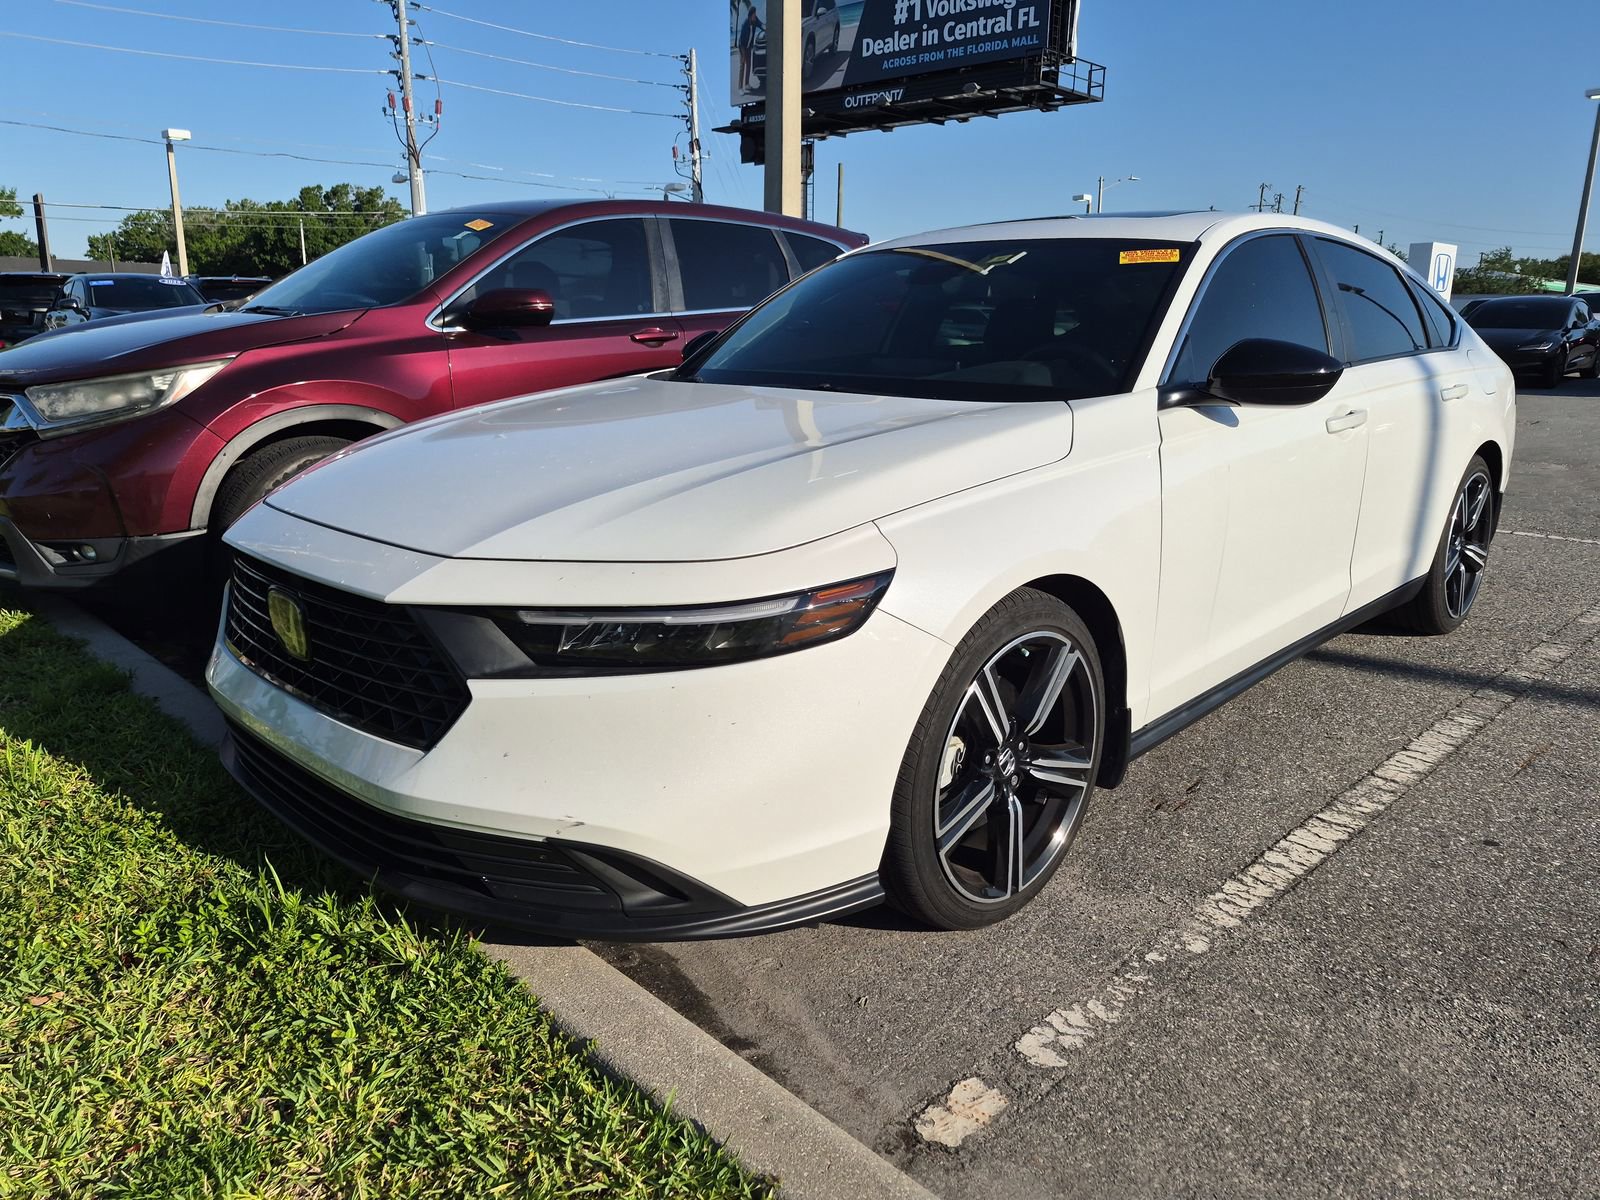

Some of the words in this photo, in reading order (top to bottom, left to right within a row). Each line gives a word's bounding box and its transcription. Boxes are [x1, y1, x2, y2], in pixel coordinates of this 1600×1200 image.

[893, 0, 921, 25] #1
[925, 0, 1024, 19] Volkswag
[862, 30, 919, 57] Dealer
[922, 23, 938, 46] in
[943, 8, 1012, 42] Central
[1018, 6, 1040, 30] FL
[882, 56, 917, 70] ACROSS
[918, 51, 945, 64] FROM
[946, 46, 964, 58] THE
[967, 39, 1009, 55] FLORIDA
[1011, 34, 1039, 48] MALL
